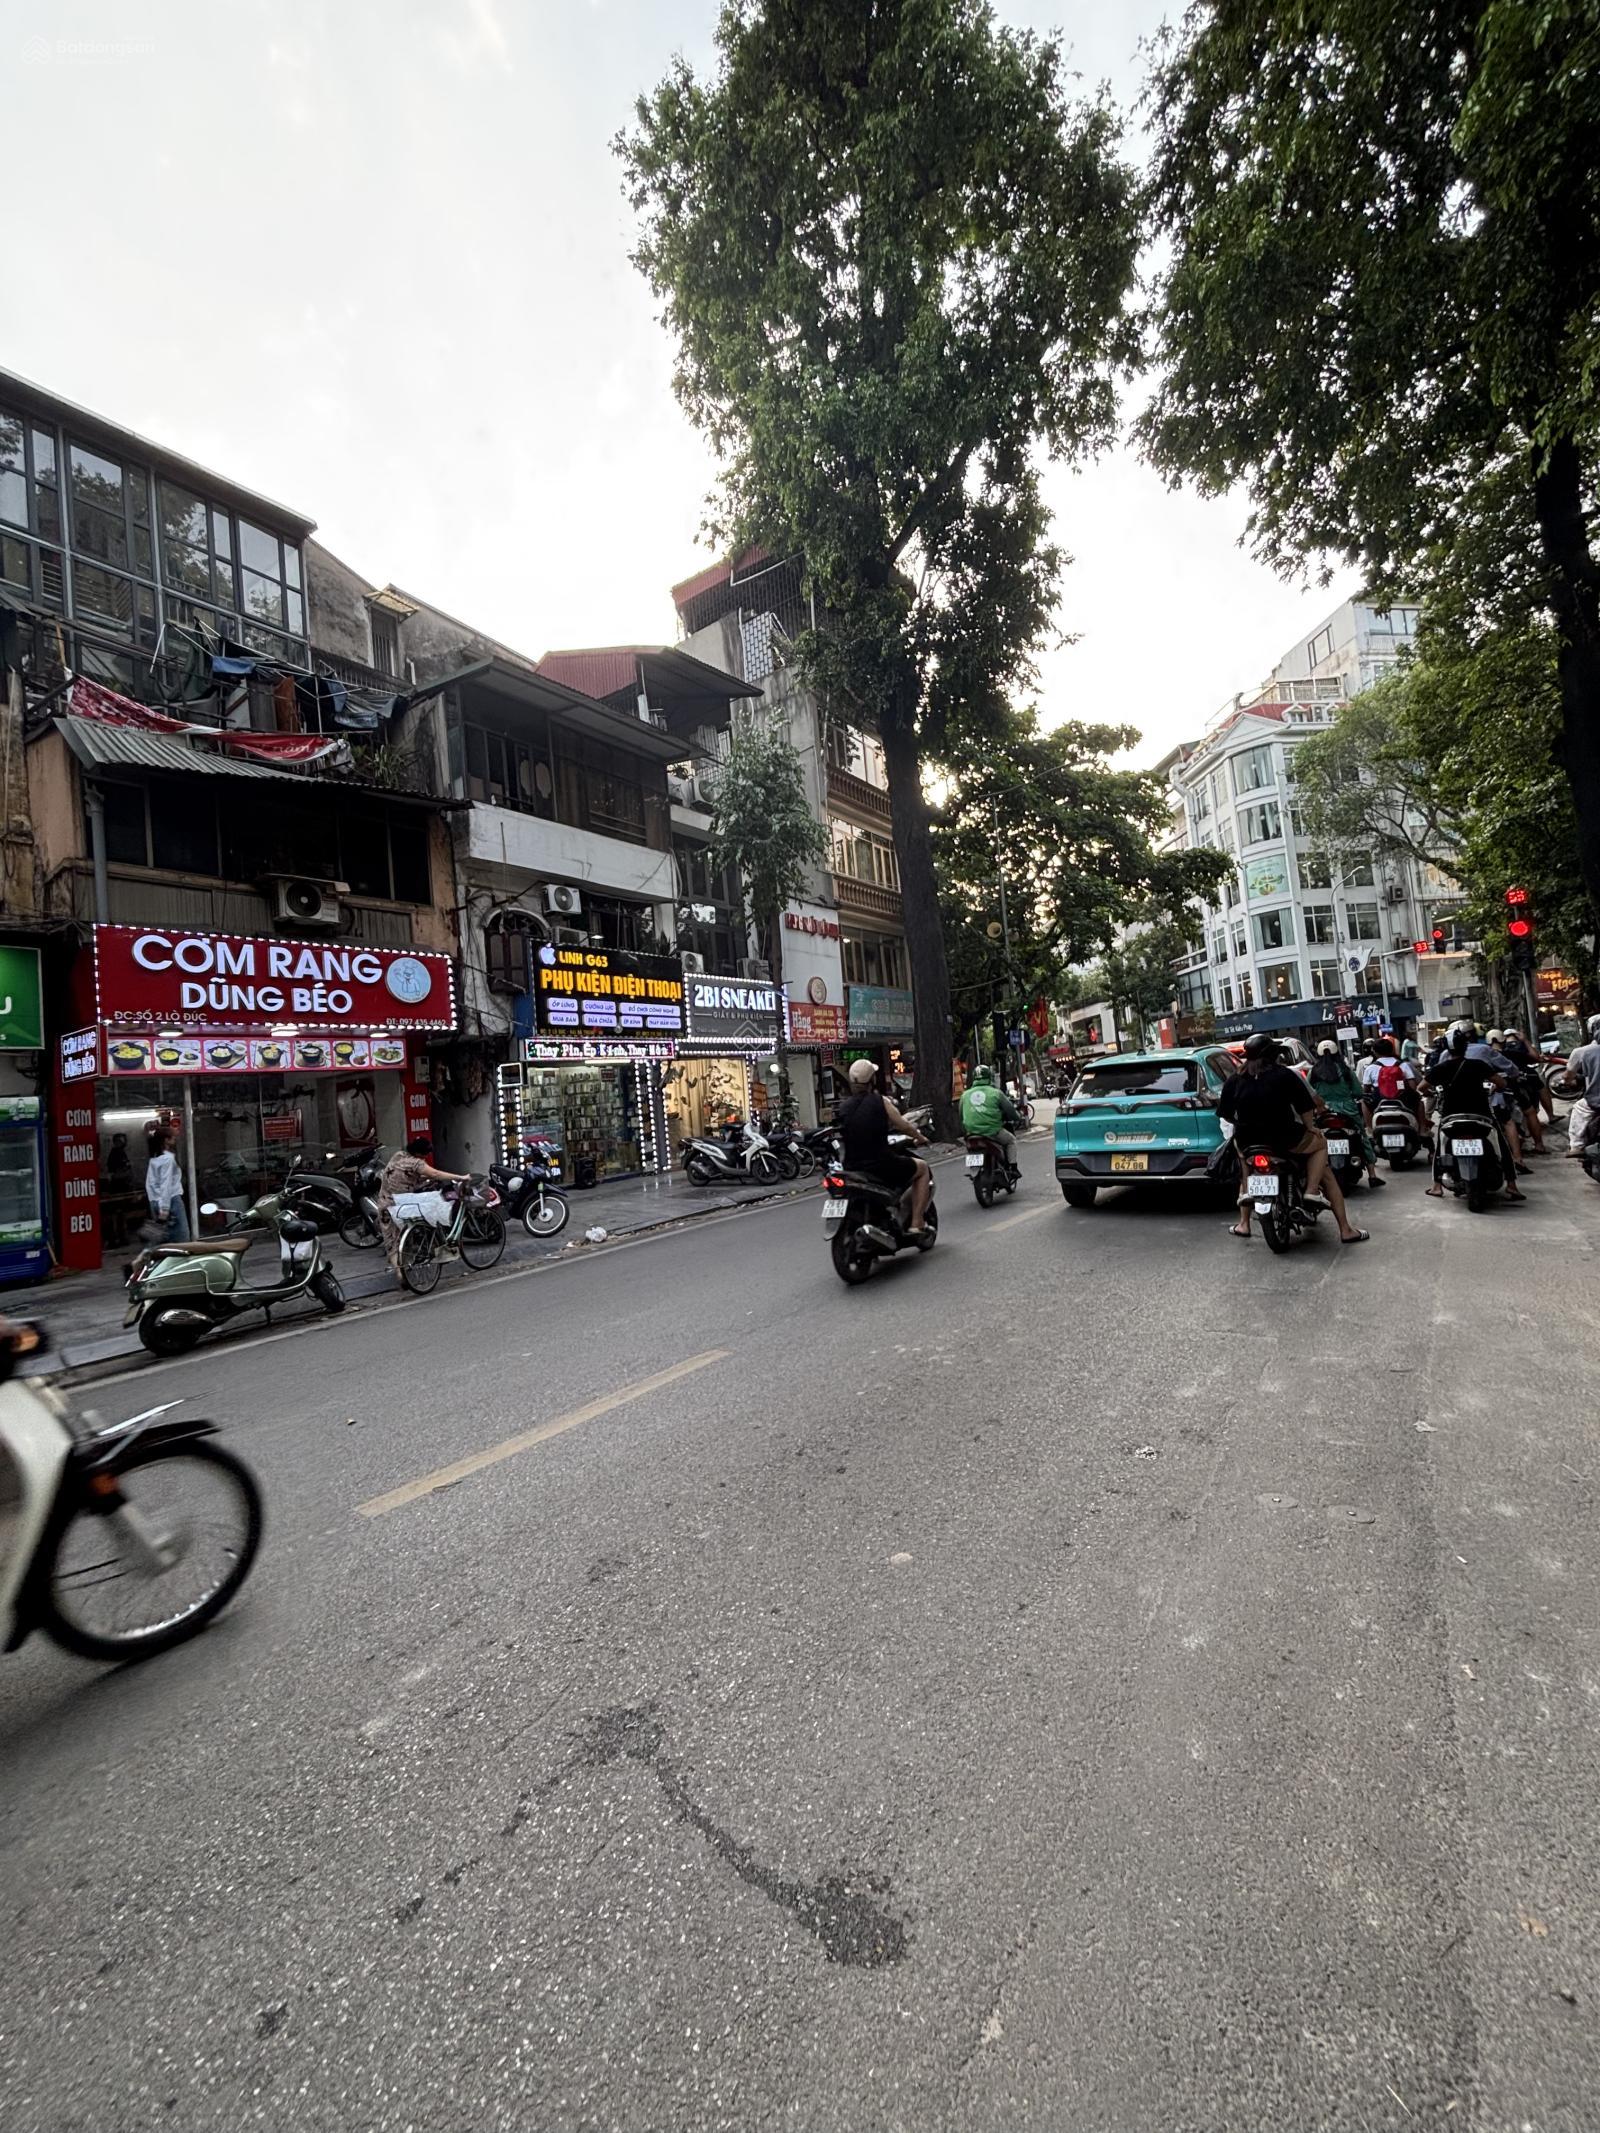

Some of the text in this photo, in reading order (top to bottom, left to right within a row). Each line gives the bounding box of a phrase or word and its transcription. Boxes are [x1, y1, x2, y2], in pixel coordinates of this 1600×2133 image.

[132, 934, 383, 984] CƠM RANG
[559, 950, 609, 968] LINH G63
[180, 977, 353, 1014] DŨNG BÉO
[540, 969, 682, 1002] PHỤ KIỆN ĐIỆN THOẠI
[694, 984, 720, 1008] 2BI
[155, 1012, 163, 1022] 2
[165, 1010, 181, 1022] LÒ
[183, 1010, 208, 1022] ĐÚC
[1322, 1008, 1335, 1022] Le
[66, 1109, 92, 1127] CƠM
[410, 1118, 429, 1132] RANG
[63, 1144, 94, 1163] RANG
[64, 1177, 96, 1199] DŨNG
[70, 1211, 93, 1233] BÉO
